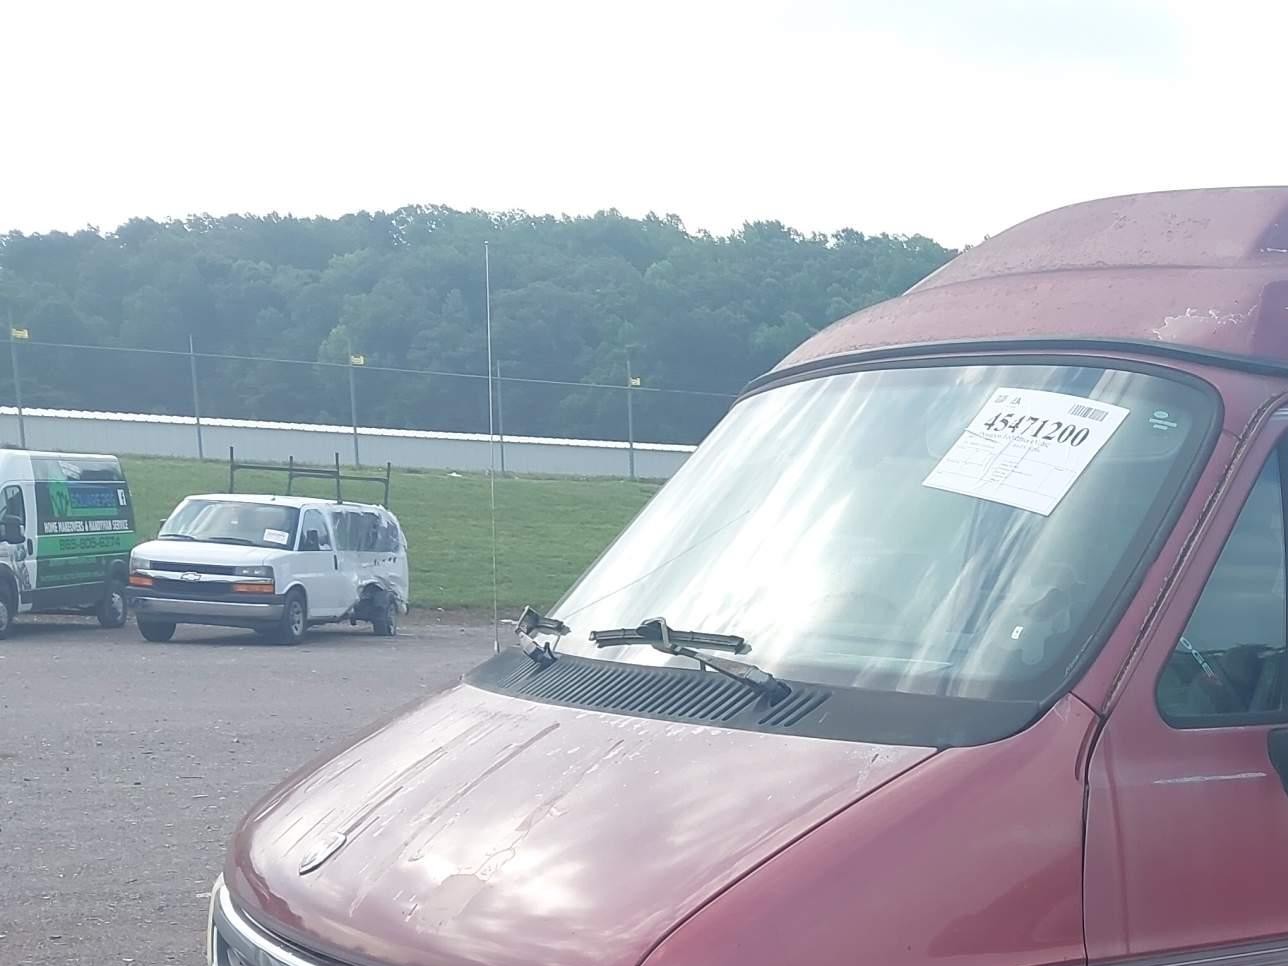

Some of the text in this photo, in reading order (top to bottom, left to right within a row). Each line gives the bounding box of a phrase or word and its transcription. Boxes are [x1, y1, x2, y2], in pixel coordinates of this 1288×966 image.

[984, 412, 1090, 447] 45471200
[43, 521, 58, 533] HOME
[112, 519, 129, 530] SERVICE
